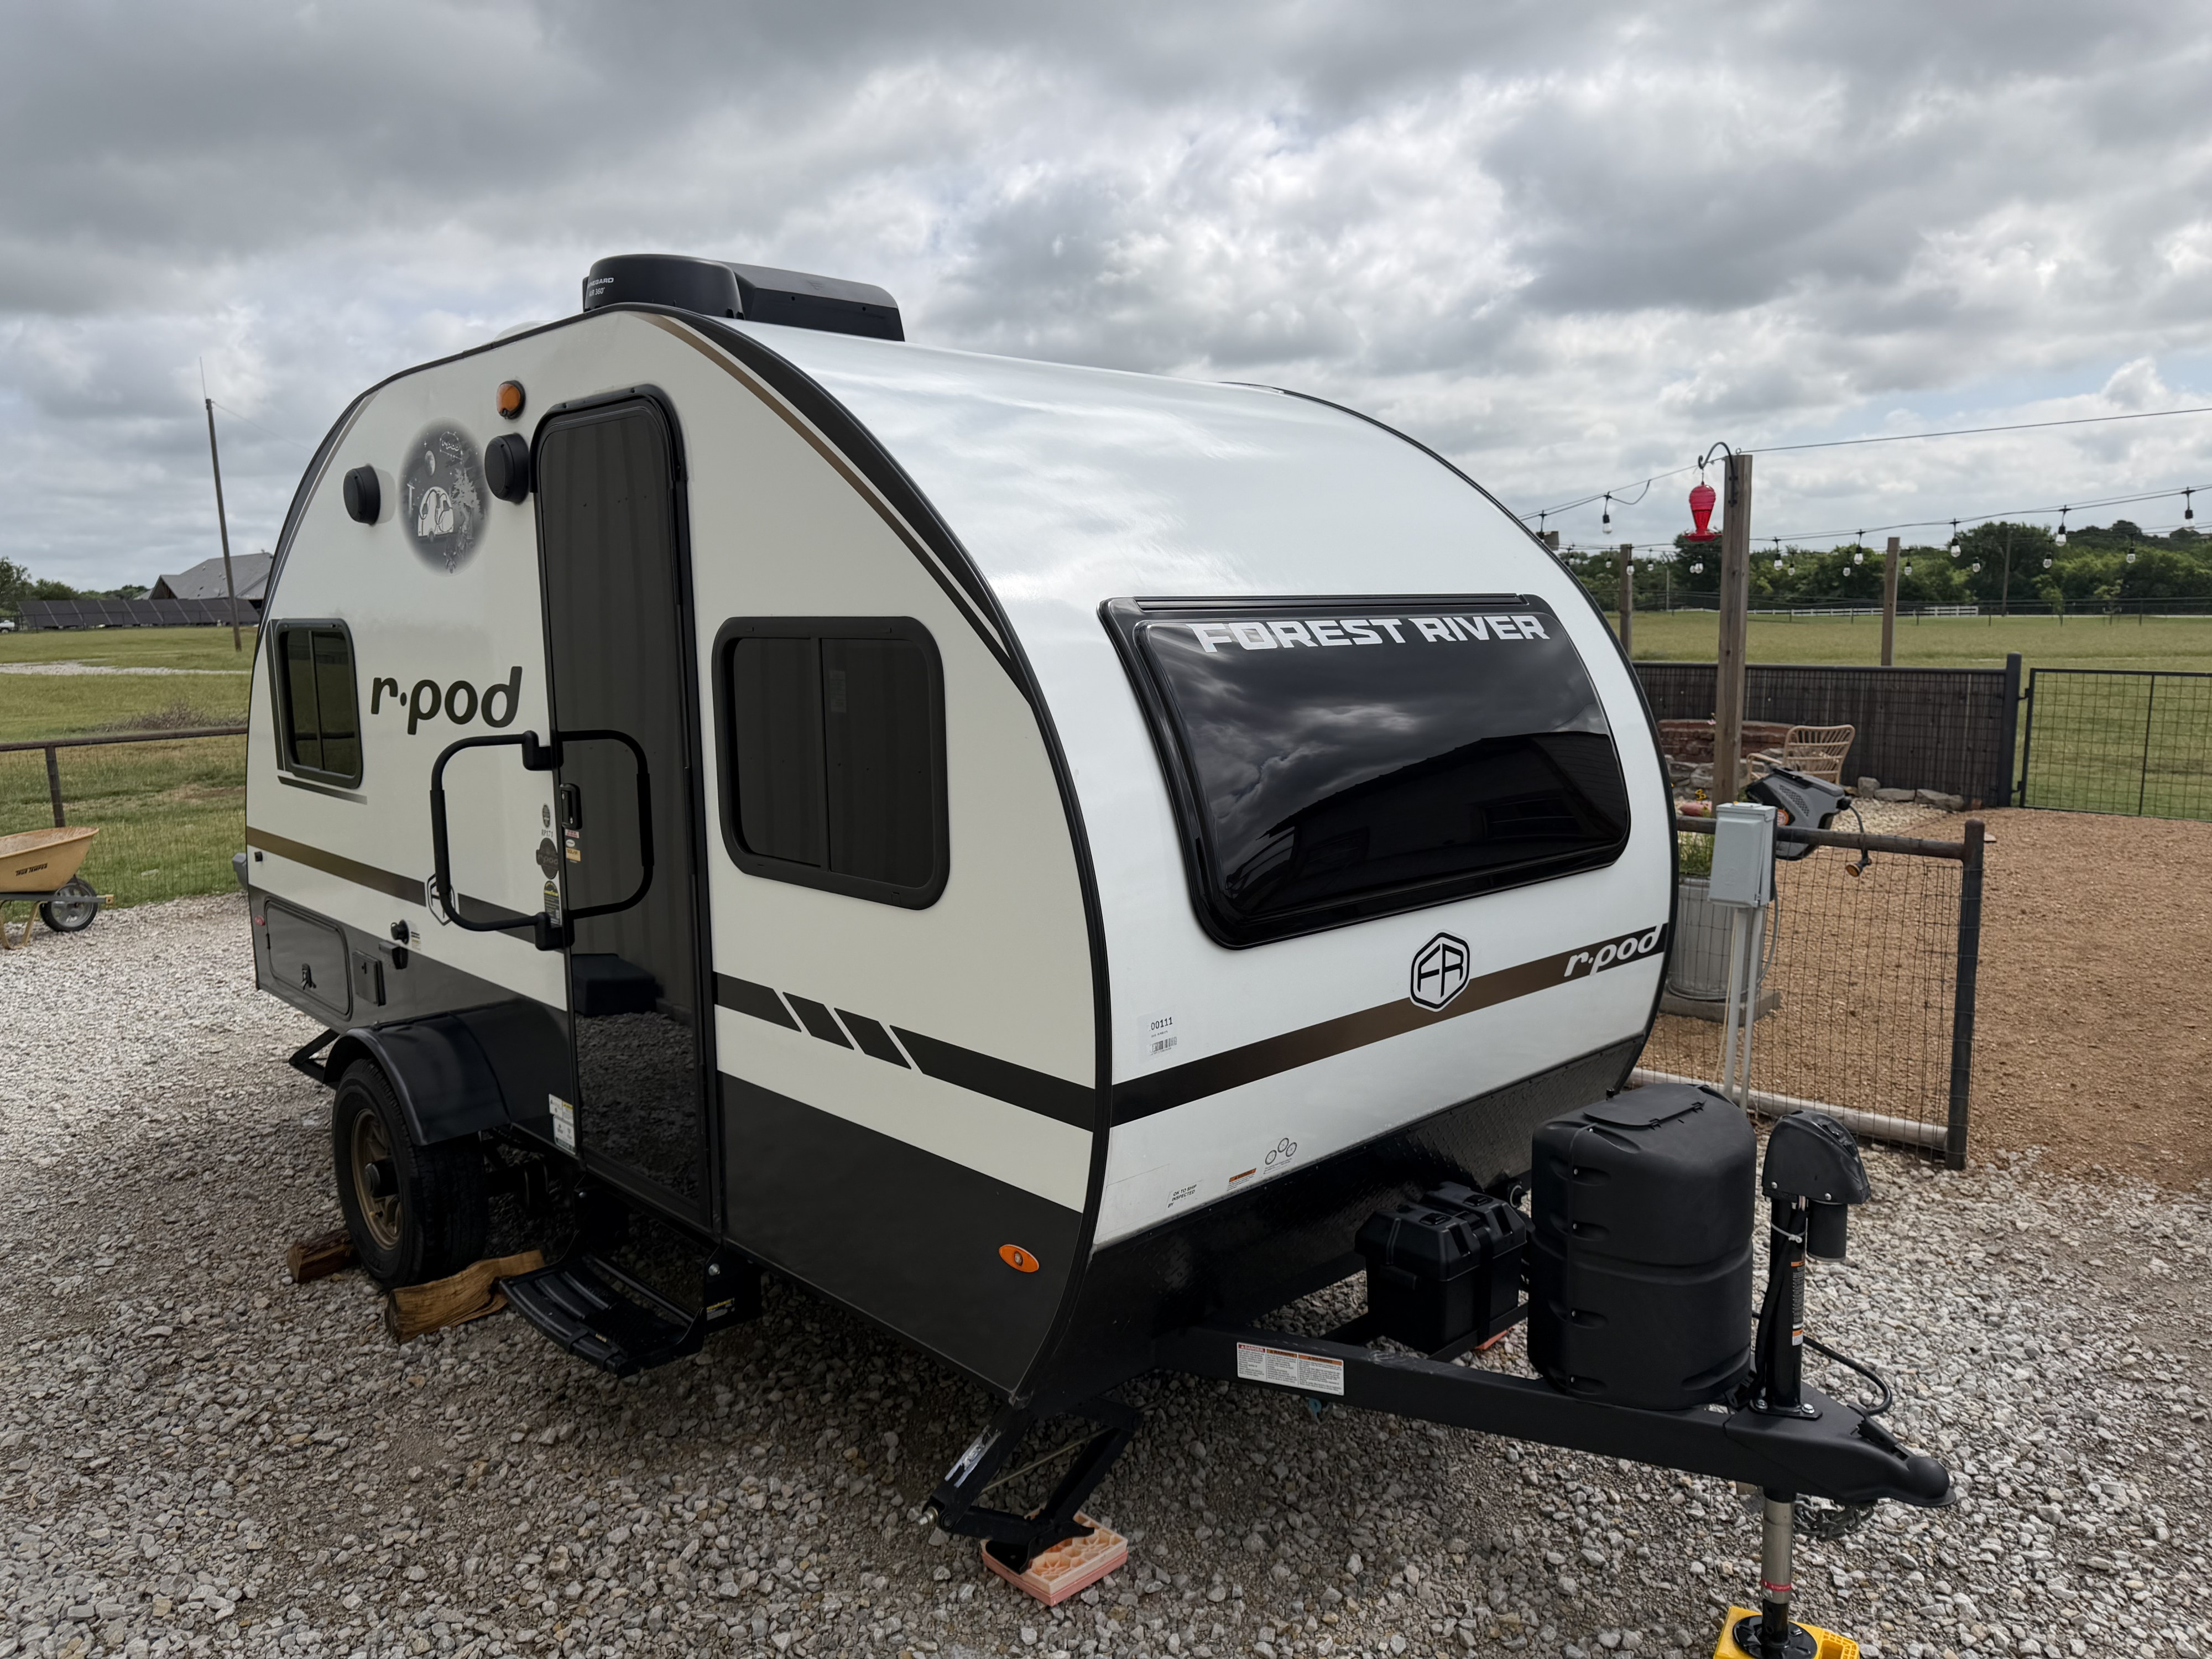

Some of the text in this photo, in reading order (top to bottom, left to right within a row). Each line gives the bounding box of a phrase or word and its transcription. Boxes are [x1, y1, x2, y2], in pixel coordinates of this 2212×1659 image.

[1186, 615, 1550, 653] FOREST RIVER
[1151, 1016, 1173, 1031] 00111
[1172, 1190, 1195, 1202] INSPECTED
